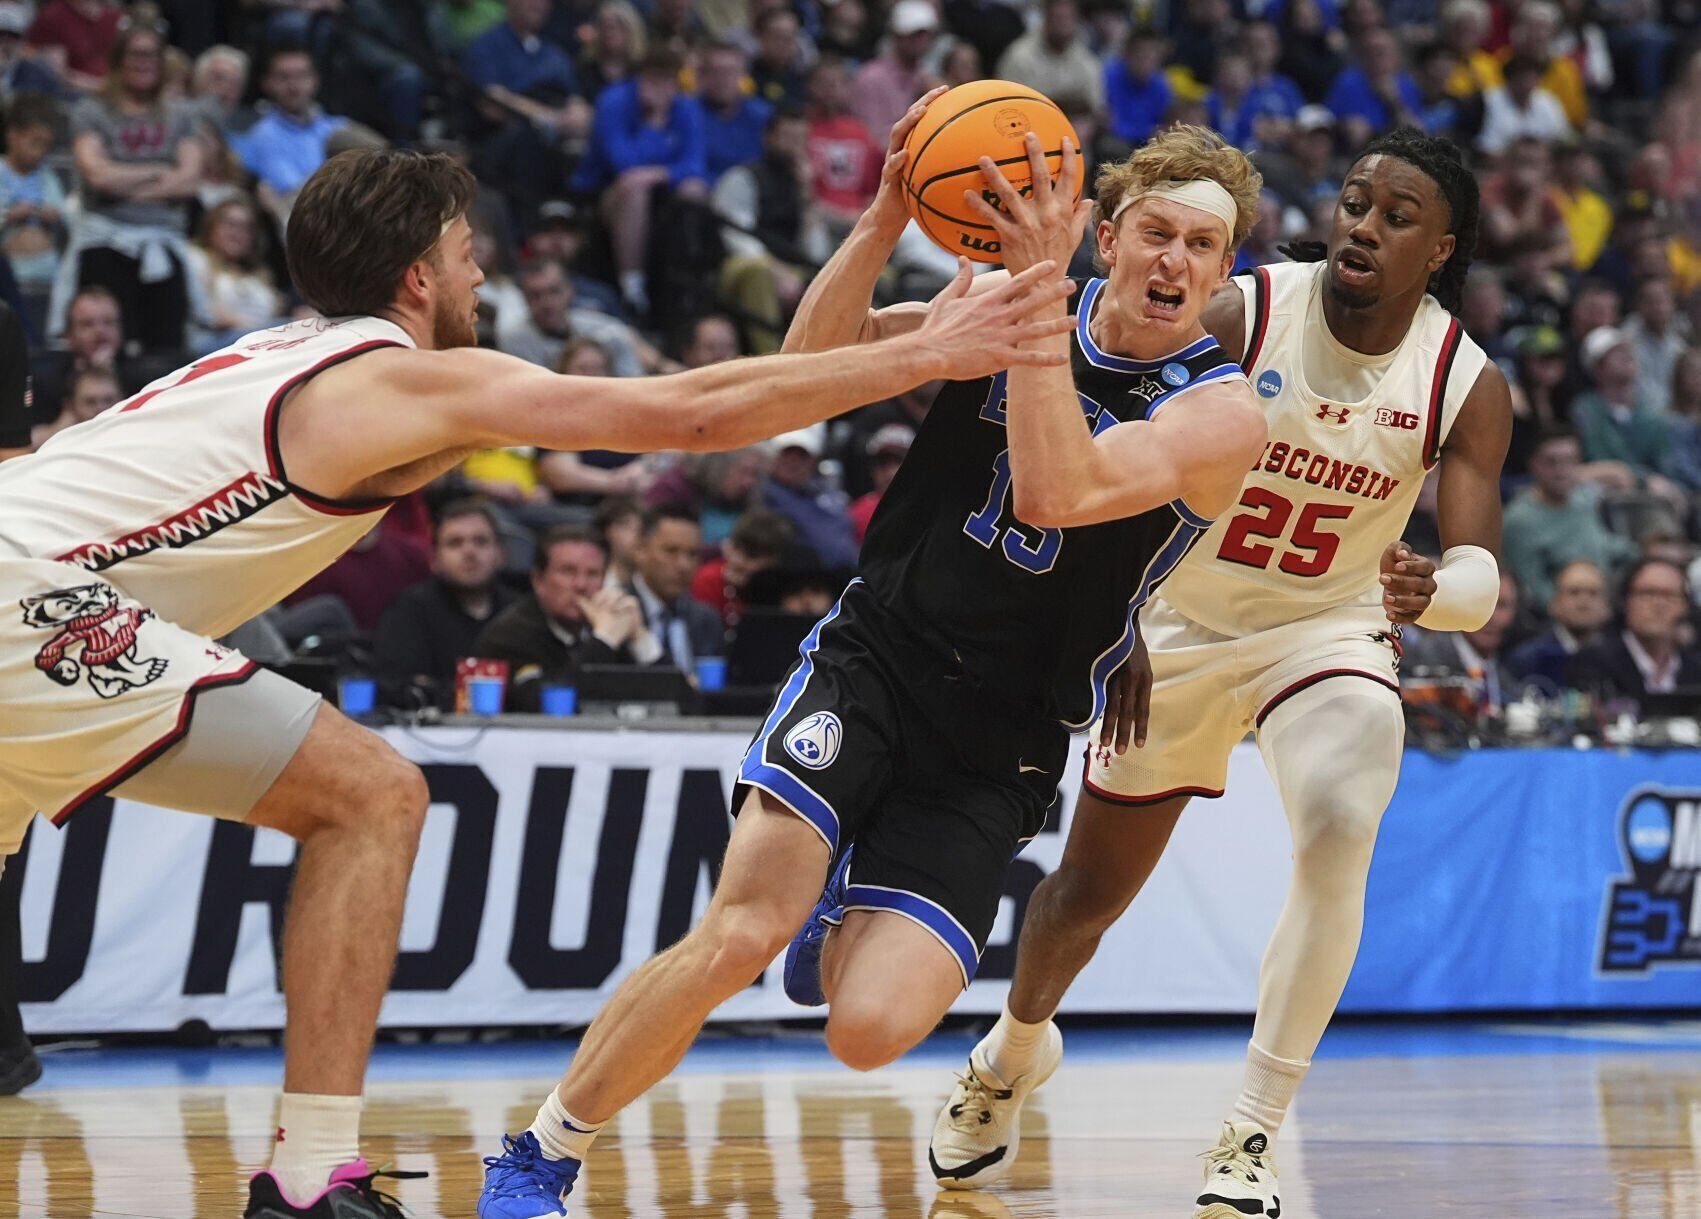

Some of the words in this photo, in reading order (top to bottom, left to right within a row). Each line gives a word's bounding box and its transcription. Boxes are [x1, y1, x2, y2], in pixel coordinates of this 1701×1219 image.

[1164, 368, 1186, 386] NCAA
[1258, 380, 1280, 394] NCAA
[1216, 486, 1355, 577] 25
